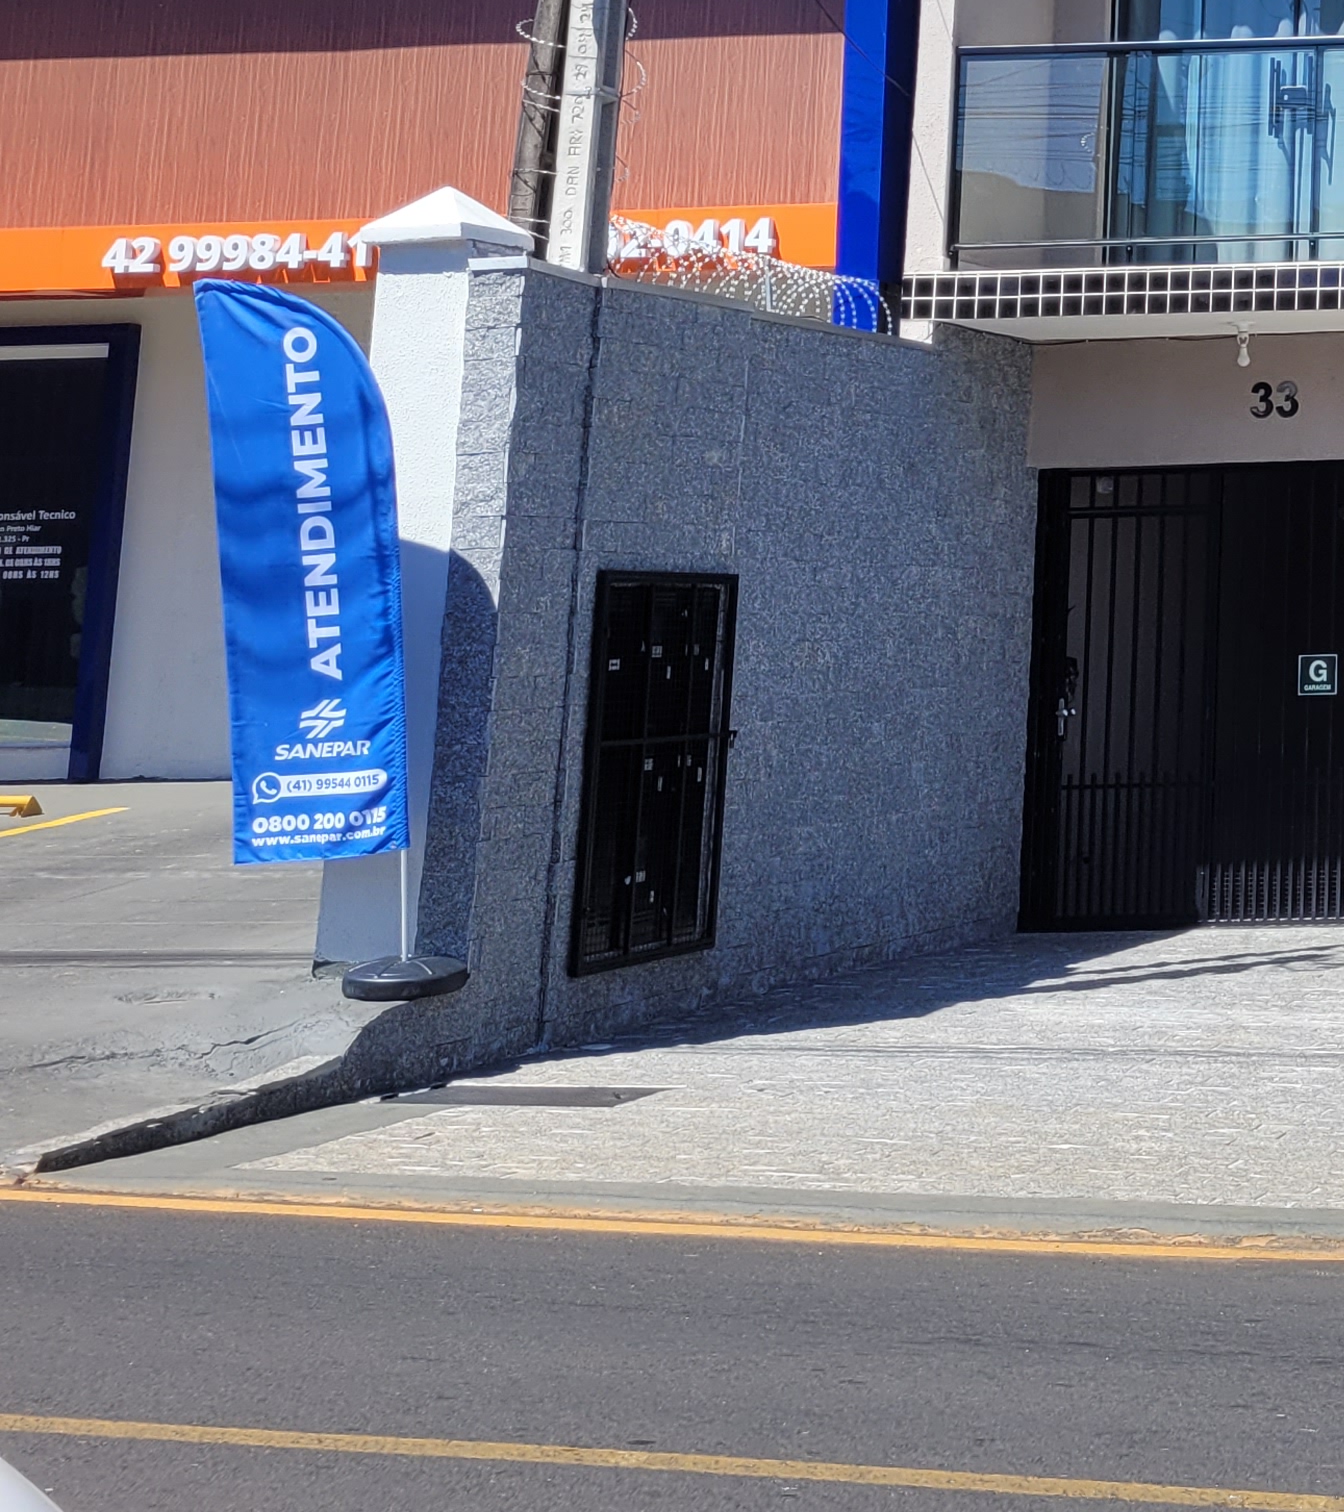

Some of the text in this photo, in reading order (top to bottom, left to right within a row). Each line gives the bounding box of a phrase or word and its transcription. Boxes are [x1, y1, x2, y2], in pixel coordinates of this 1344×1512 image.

[101, 237, 160, 274] 42
[1250, 380, 1299, 419] 33
[38, 509, 76, 520] Tecnico
[282, 326, 343, 681] ATENDIMENTO
[1308, 659, 1328, 682] G
[1304, 684, 1332, 692] GARAGEM
[274, 740, 371, 761] SANEPAR
[286, 774, 380, 793] (41) 99544 0115
[252, 806, 387, 834] 0800 200 0115
[252, 826, 387, 847] www.sanepar.com.br
